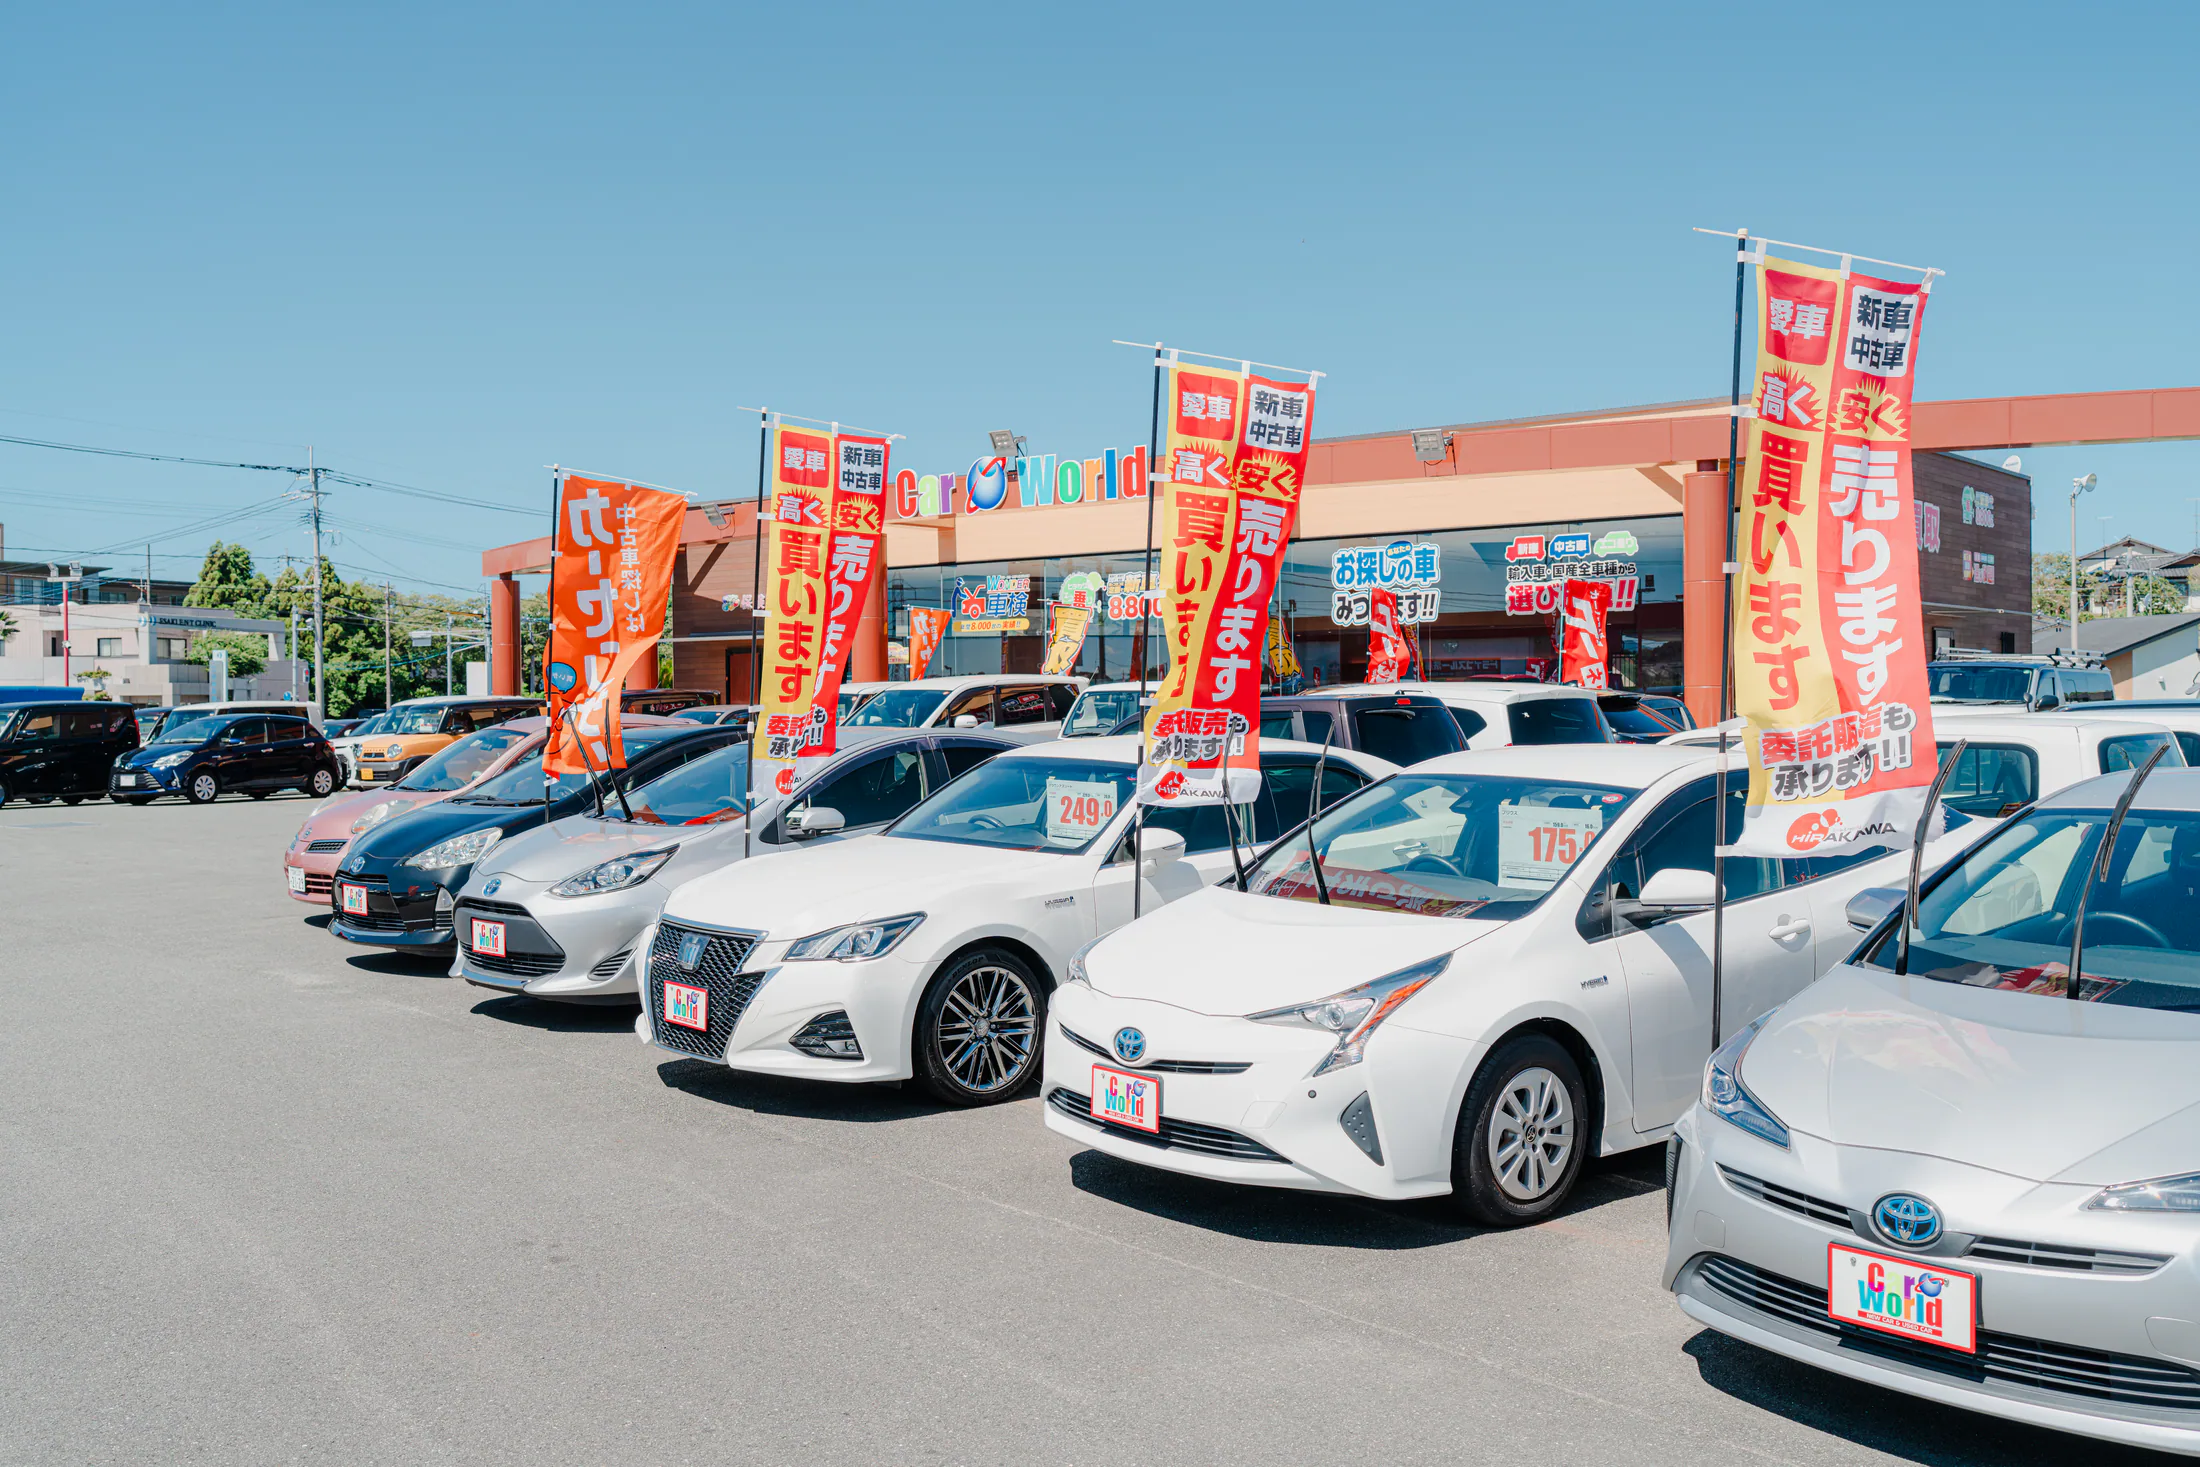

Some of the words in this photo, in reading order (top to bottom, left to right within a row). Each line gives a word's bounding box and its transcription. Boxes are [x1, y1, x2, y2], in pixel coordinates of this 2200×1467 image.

[1769, 296, 1829, 340] 愛車
[1857, 294, 1914, 333] 新車
[1850, 334, 1906, 370] 中古車
[1182, 391, 1232, 422] 愛車
[1254, 390, 1304, 419] 新車
[1761, 375, 1812, 426] 高く
[1840, 392, 1900, 436] 安く
[1249, 420, 1303, 447] 中古車
[784, 446, 826, 473] 愛車
[843, 445, 883, 468] 新車
[1175, 450, 1230, 486] 高く
[842, 469, 882, 491] 中古車
[895, 468, 955, 519] Car
[1016, 444, 1148, 508] World
[1238, 462, 1293, 497] 安く
[779, 495, 823, 525] 高く
[839, 504, 877, 531] 安く
[1554, 540, 1587, 552] 中古車
[1336, 547, 1436, 586] お探しの車
[1749, 430, 1812, 711] 買います
[1828, 444, 1903, 705] 売ります
[987, 575, 1030, 590] WONDER
[1508, 580, 1636, 612] 選び!!
[775, 529, 822, 703] 買います
[986, 592, 1029, 617] 車検
[1210, 498, 1287, 703] 売ります
[1336, 592, 1436, 621] みつす!!
[195, 620, 216, 628] CLINIC
[812, 535, 874, 700] 売ります
[766, 708, 826, 737] 委託も
[1762, 705, 1912, 766] 委託販売も
[1151, 735, 1242, 760] 承ります!
[1774, 736, 1907, 797] 承ります!!
[1060, 796, 1113, 827] 249.0
[673, 998, 698, 1020] World
[1104, 1088, 1144, 1118] World
[1110, 1076, 1132, 1099] Car
[1868, 1262, 1915, 1300] Car
[1857, 1279, 1943, 1329] World
[1866, 1313, 1881, 1323] NEW
[1882, 1316, 1894, 1325] CAR
[1902, 1320, 1919, 1331] USED
[1920, 1326, 1933, 1335] CAR
